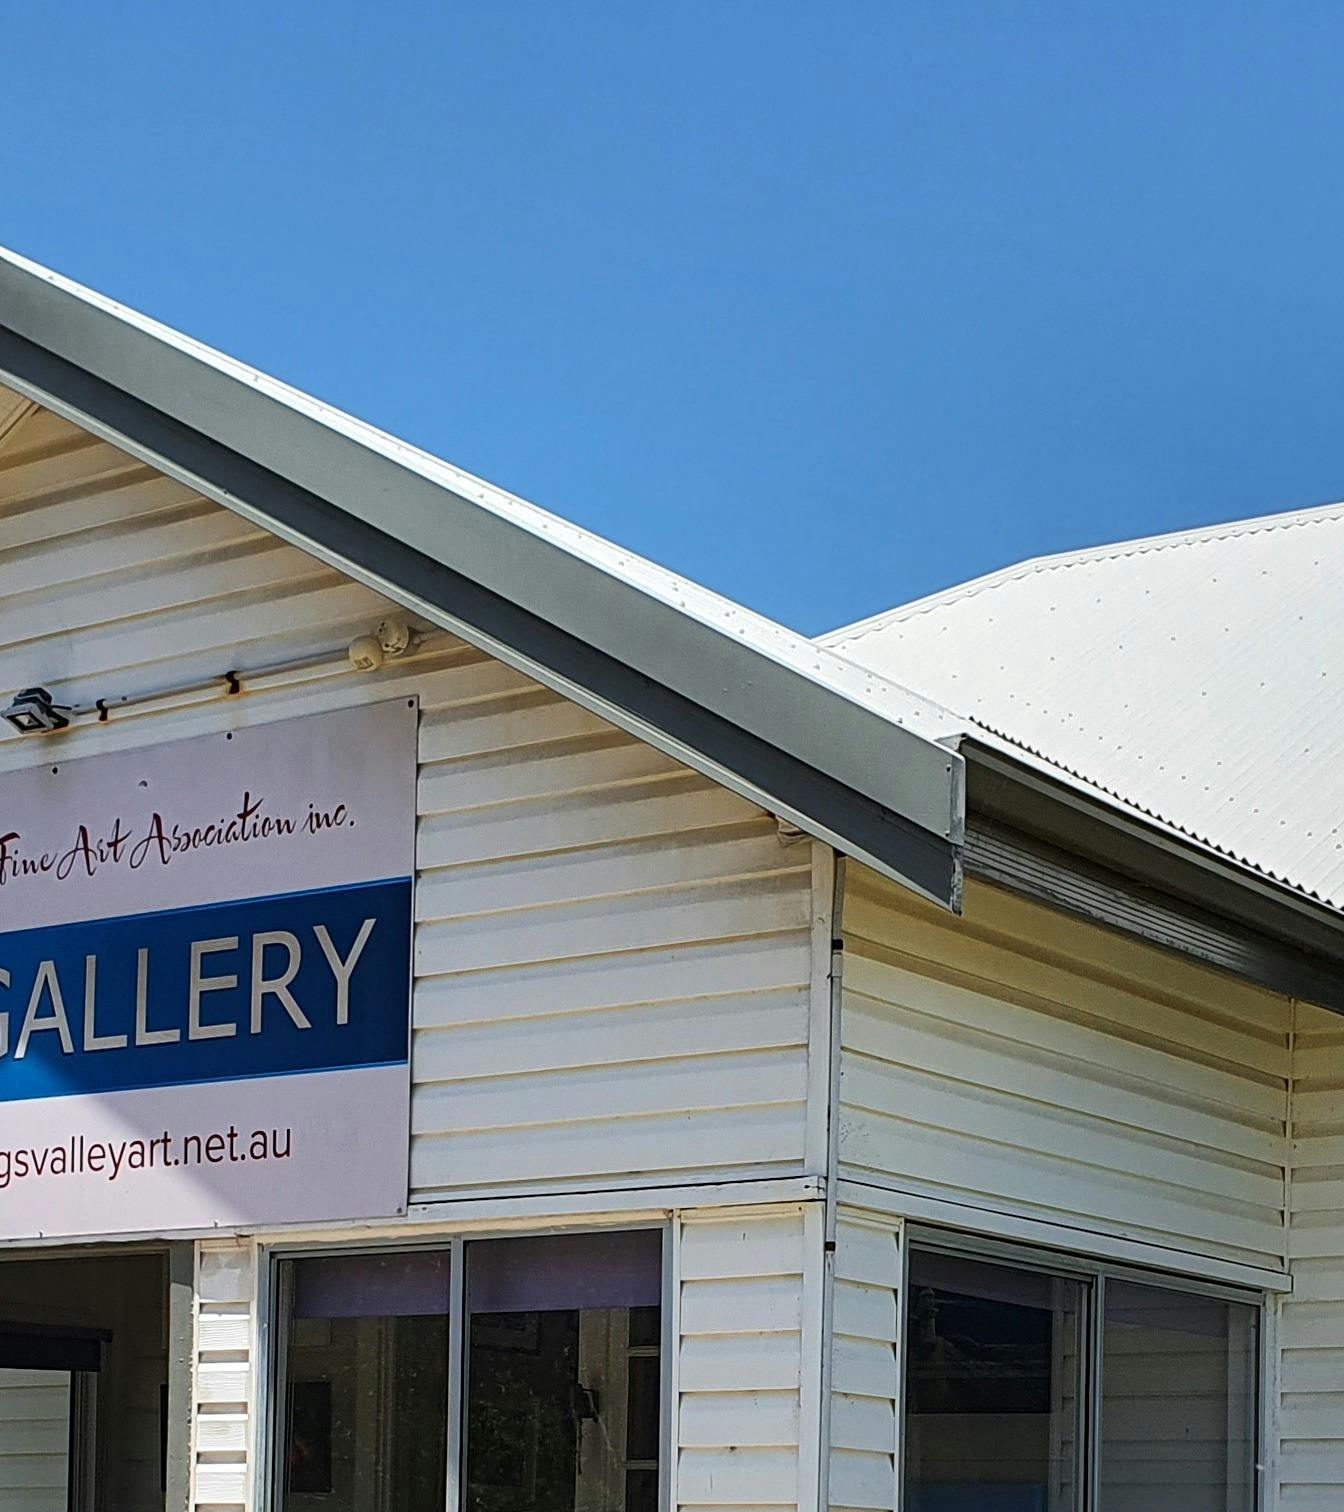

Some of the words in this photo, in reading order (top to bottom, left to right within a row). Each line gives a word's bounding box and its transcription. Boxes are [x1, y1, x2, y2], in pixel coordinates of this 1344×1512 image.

[56, 818, 132, 880] Art
[130, 791, 296, 869] Association
[303, 803, 355, 834] inc.
